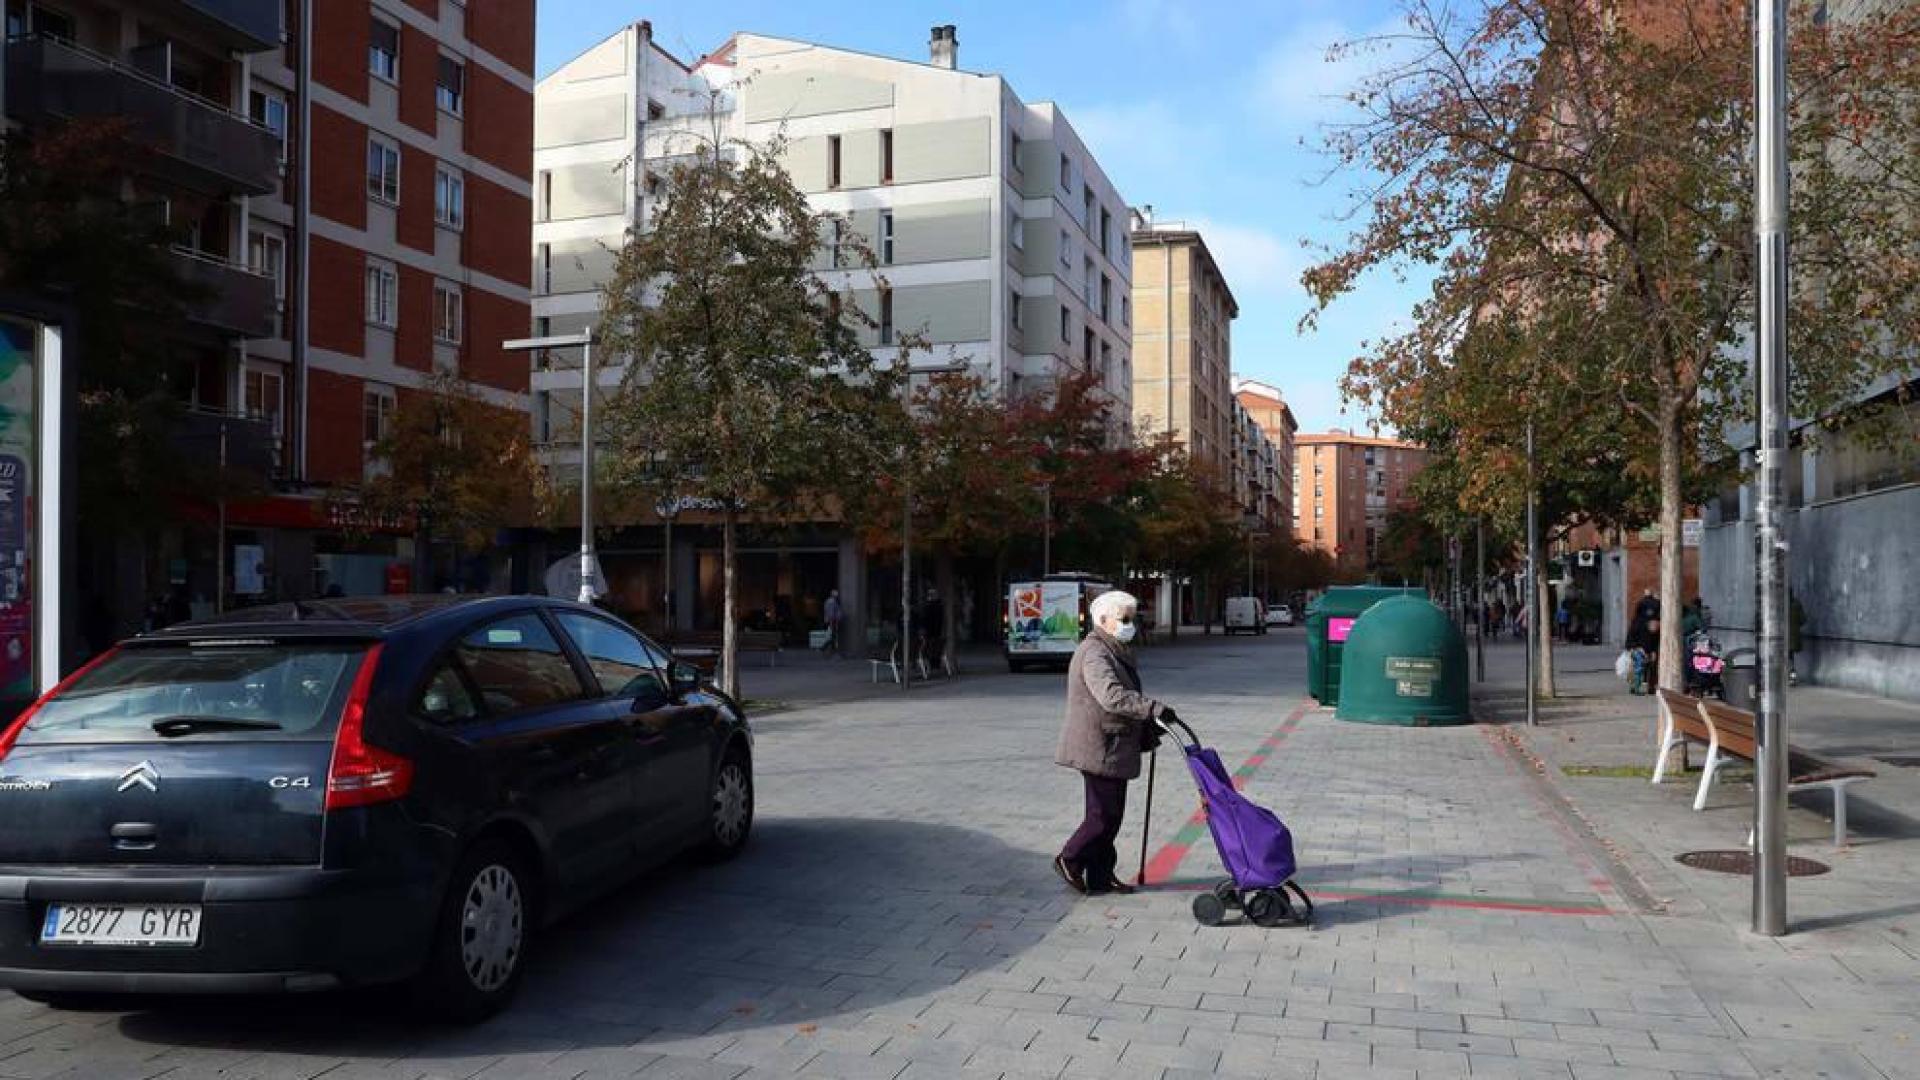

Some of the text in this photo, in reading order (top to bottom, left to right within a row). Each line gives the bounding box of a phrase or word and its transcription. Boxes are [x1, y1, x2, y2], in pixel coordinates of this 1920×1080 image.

[269, 776, 311, 788] C4
[62, 907, 124, 935] 2877
[141, 908, 194, 937] GYR
